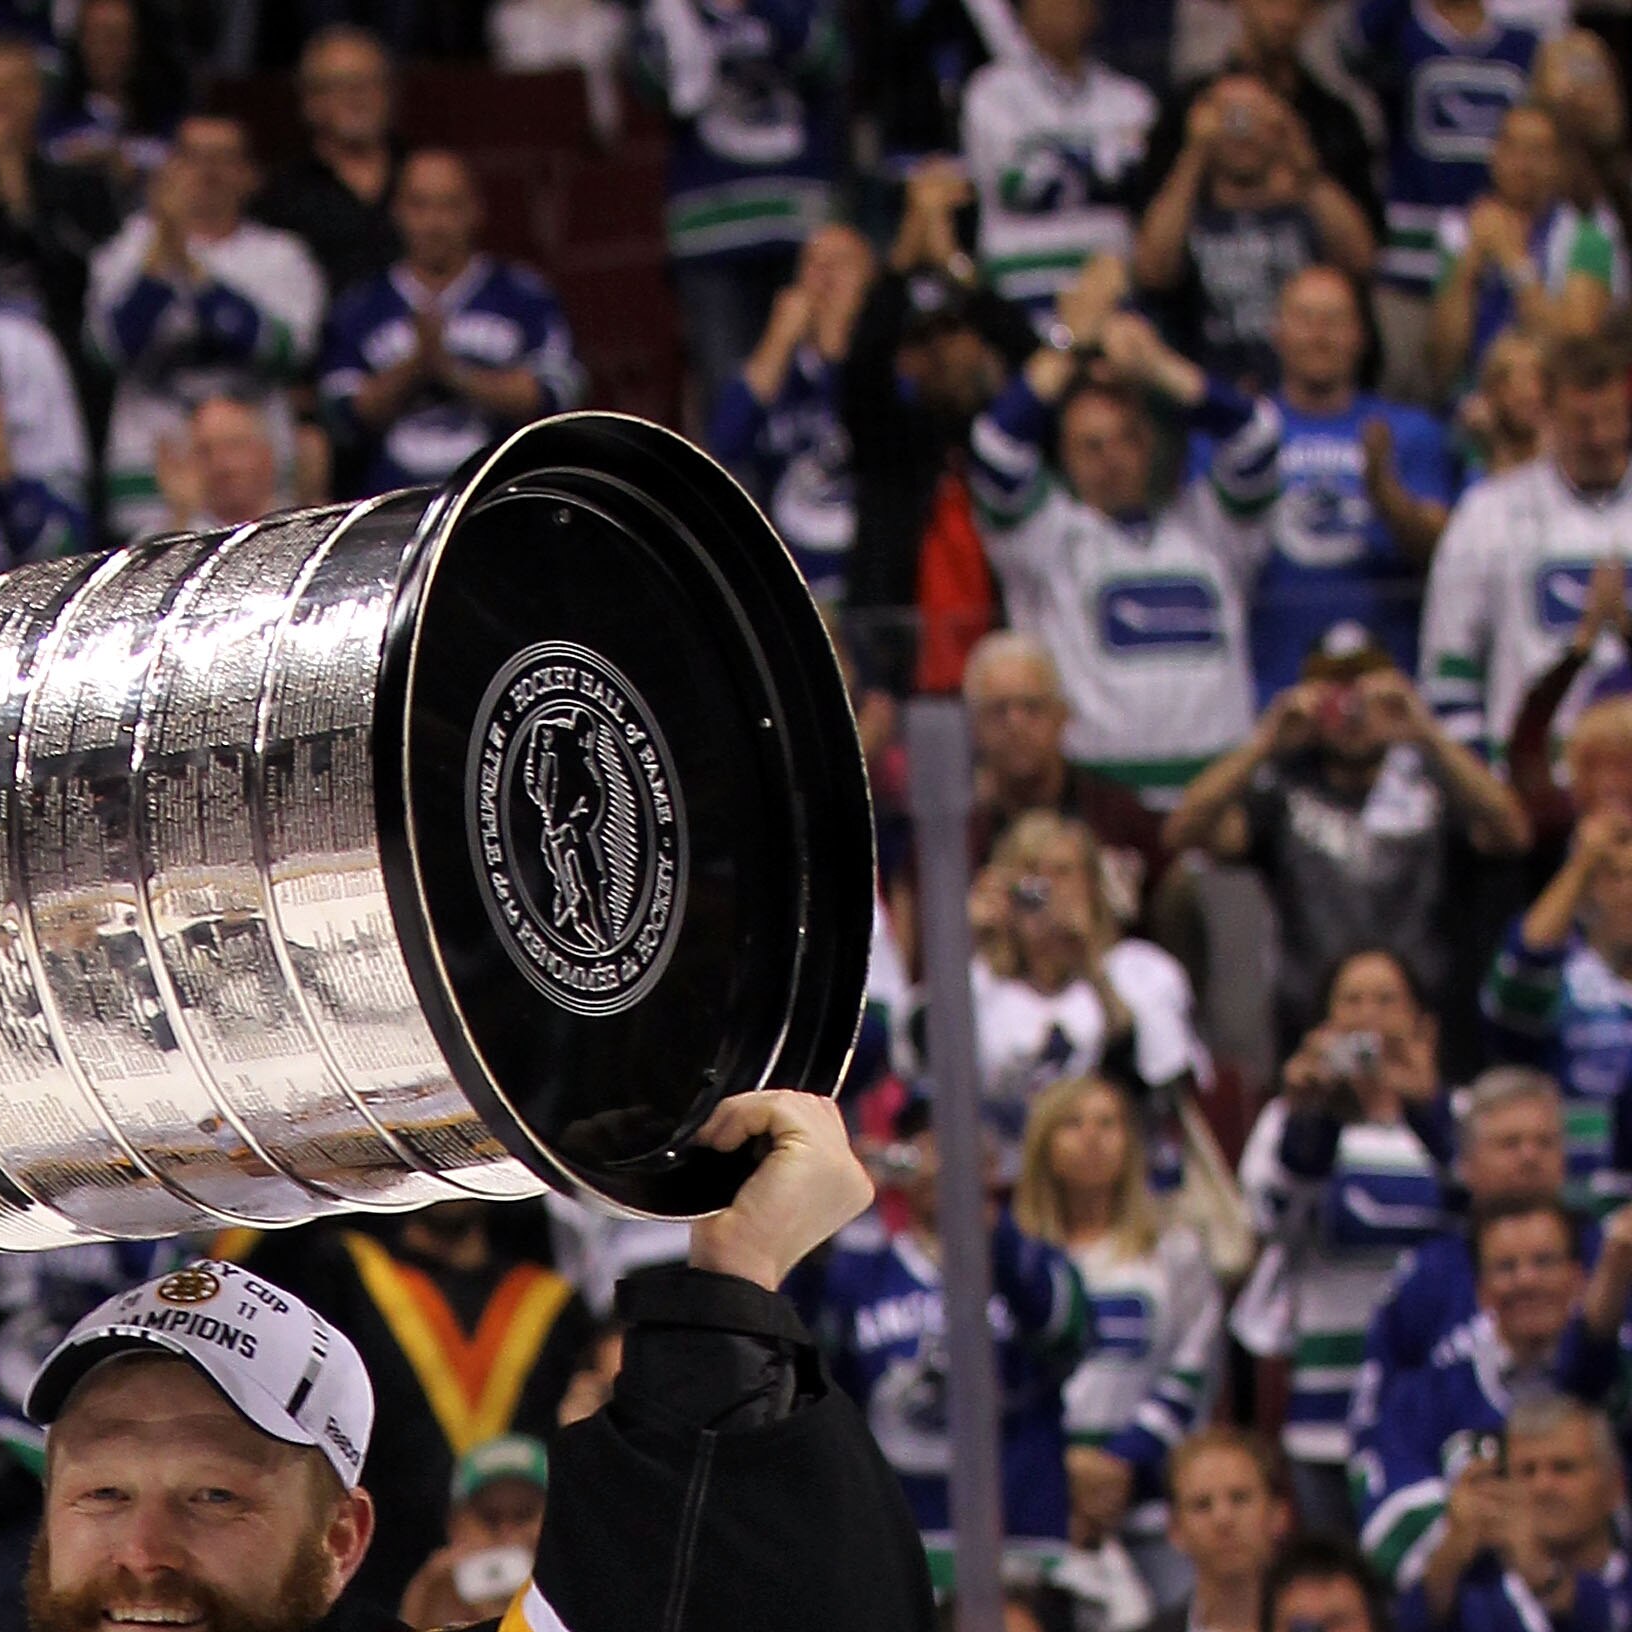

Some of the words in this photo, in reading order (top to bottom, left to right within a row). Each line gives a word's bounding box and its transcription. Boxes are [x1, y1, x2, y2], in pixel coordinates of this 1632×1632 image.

[509, 666, 576, 712] HOCKEY
[579, 671, 626, 723] HALL
[625, 723, 647, 744] of
[638, 746, 673, 825] FAME
[237, 1301, 257, 1320] 11
[244, 1279, 289, 1315] CUP
